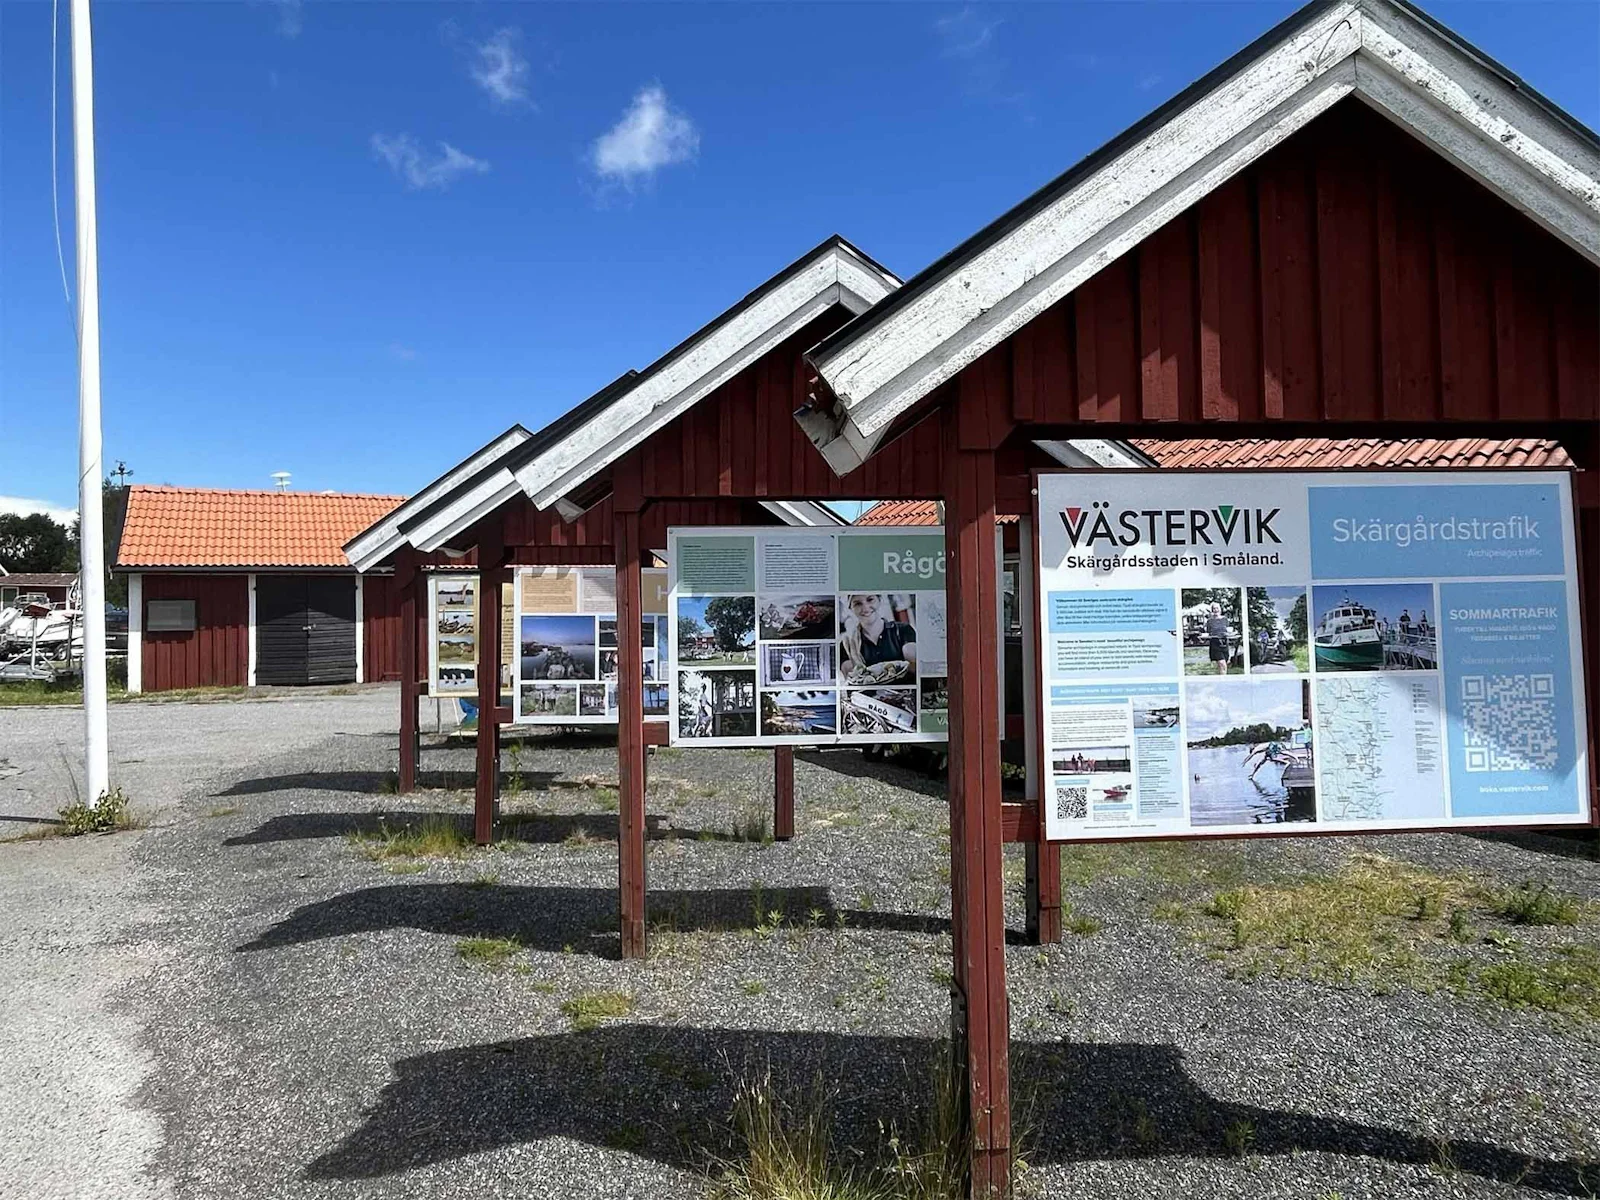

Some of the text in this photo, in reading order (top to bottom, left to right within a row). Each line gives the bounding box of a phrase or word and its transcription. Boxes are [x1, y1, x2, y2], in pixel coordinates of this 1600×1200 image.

[1059, 502, 1282, 548] VÄSTERVIK
[1333, 515, 1540, 547] Skärgårdstrafik
[1067, 552, 1284, 571] Skärgårdsstaden i Småland.
[1467, 548, 1517, 559] Archipelago
[883, 550, 947, 579] Rågö
[1449, 607, 1558, 621] SOMMARTRAFIK
[868, 704, 888, 716] RÅGÖ
